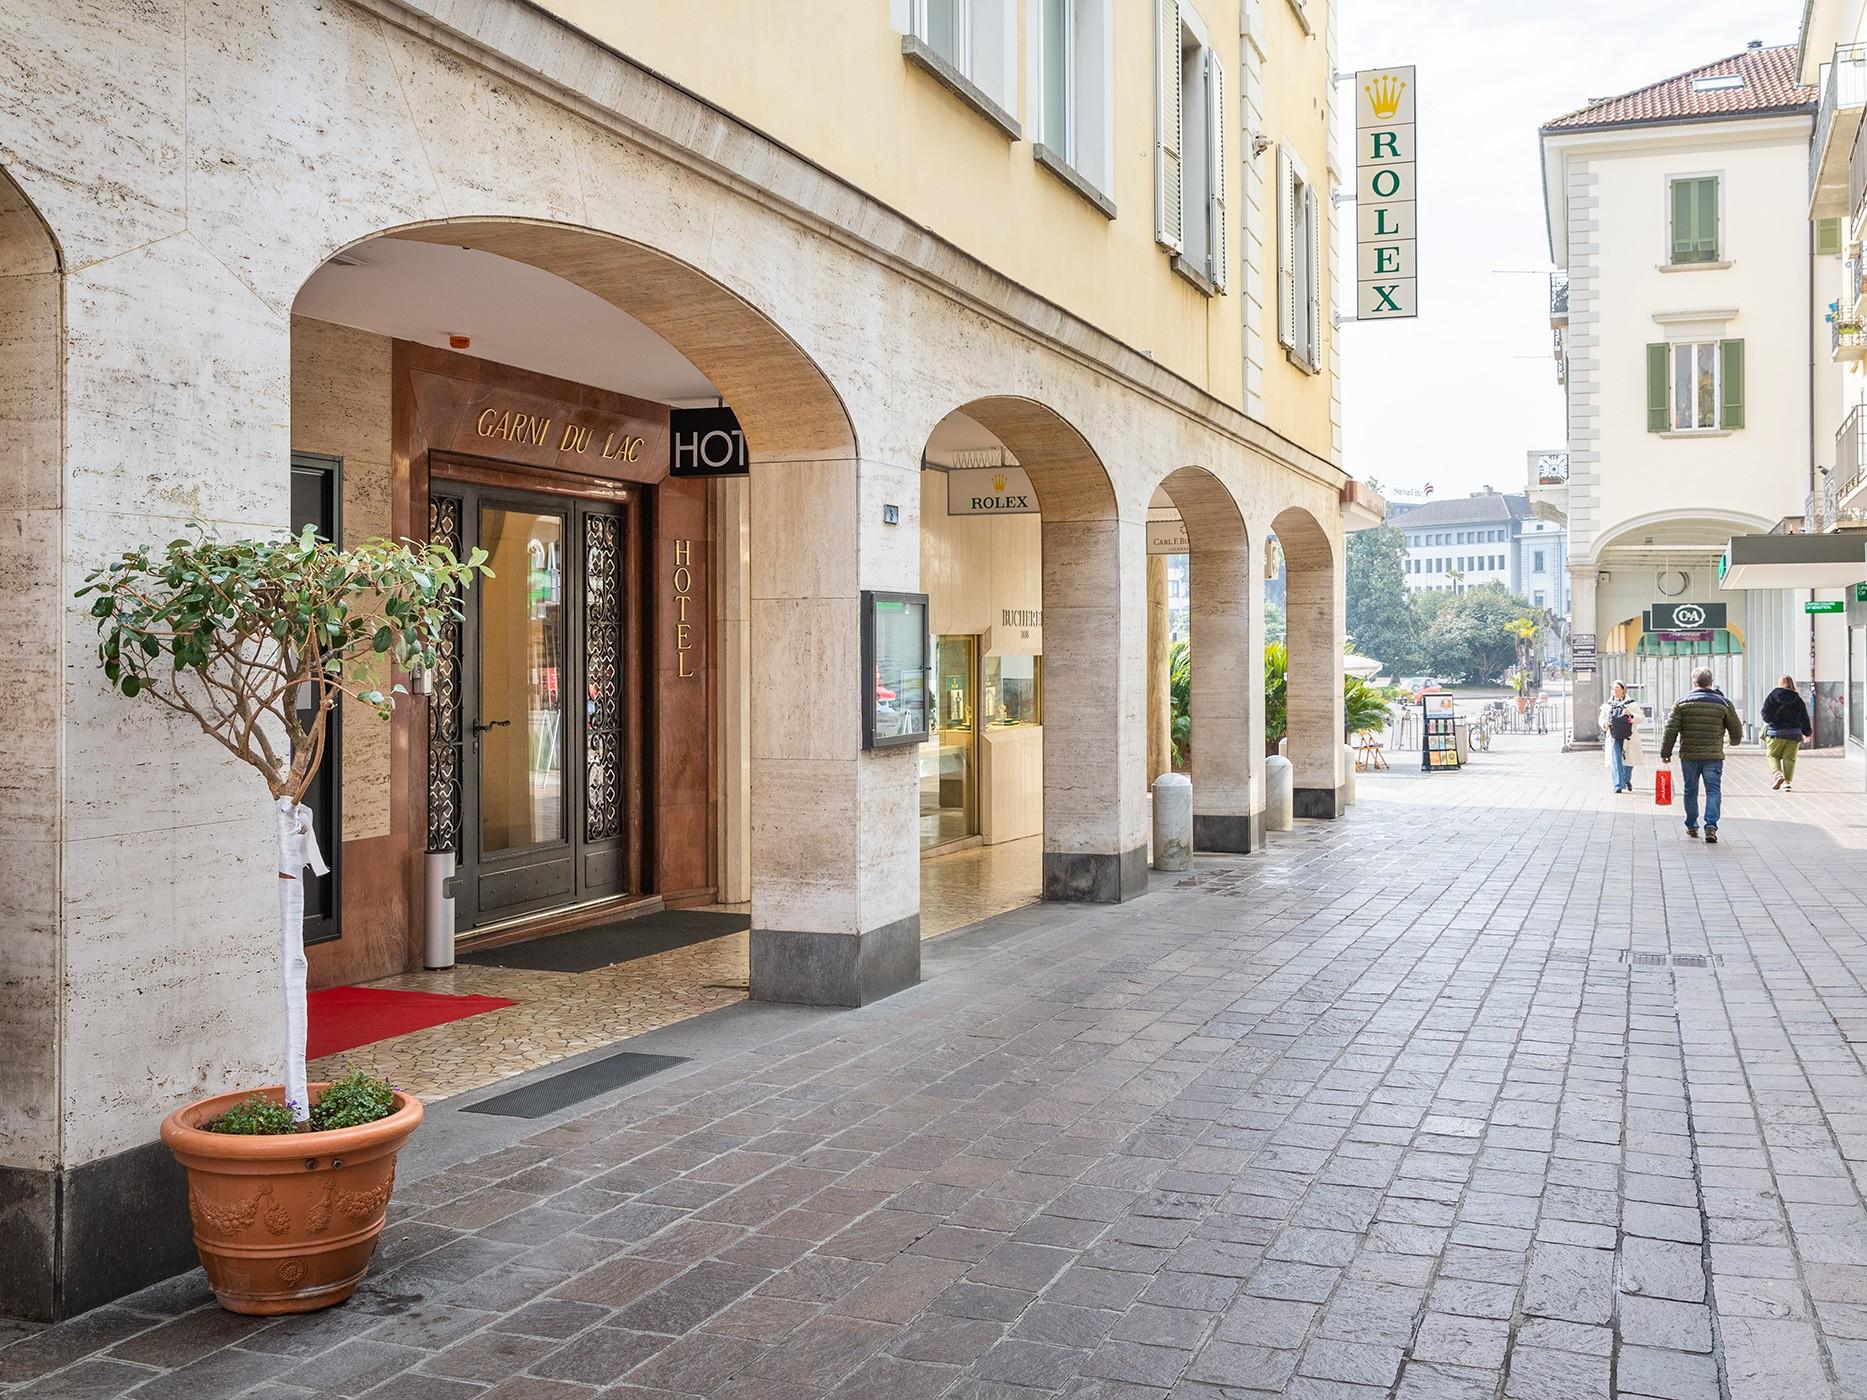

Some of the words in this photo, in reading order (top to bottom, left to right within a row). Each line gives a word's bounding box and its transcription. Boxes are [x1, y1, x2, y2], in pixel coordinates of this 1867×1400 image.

[1370, 131, 1402, 312] ROLEX
[477, 408, 551, 446] GARNI
[559, 424, 593, 454] DU
[602, 432, 645, 463] LAC
[971, 496, 1028, 509] ROLEX
[1153, 537, 1173, 545] CARL
[674, 540, 694, 678] HOTEL
[1002, 609, 1042, 627] BUCHERE
[1678, 610, 1700, 622] C&A
